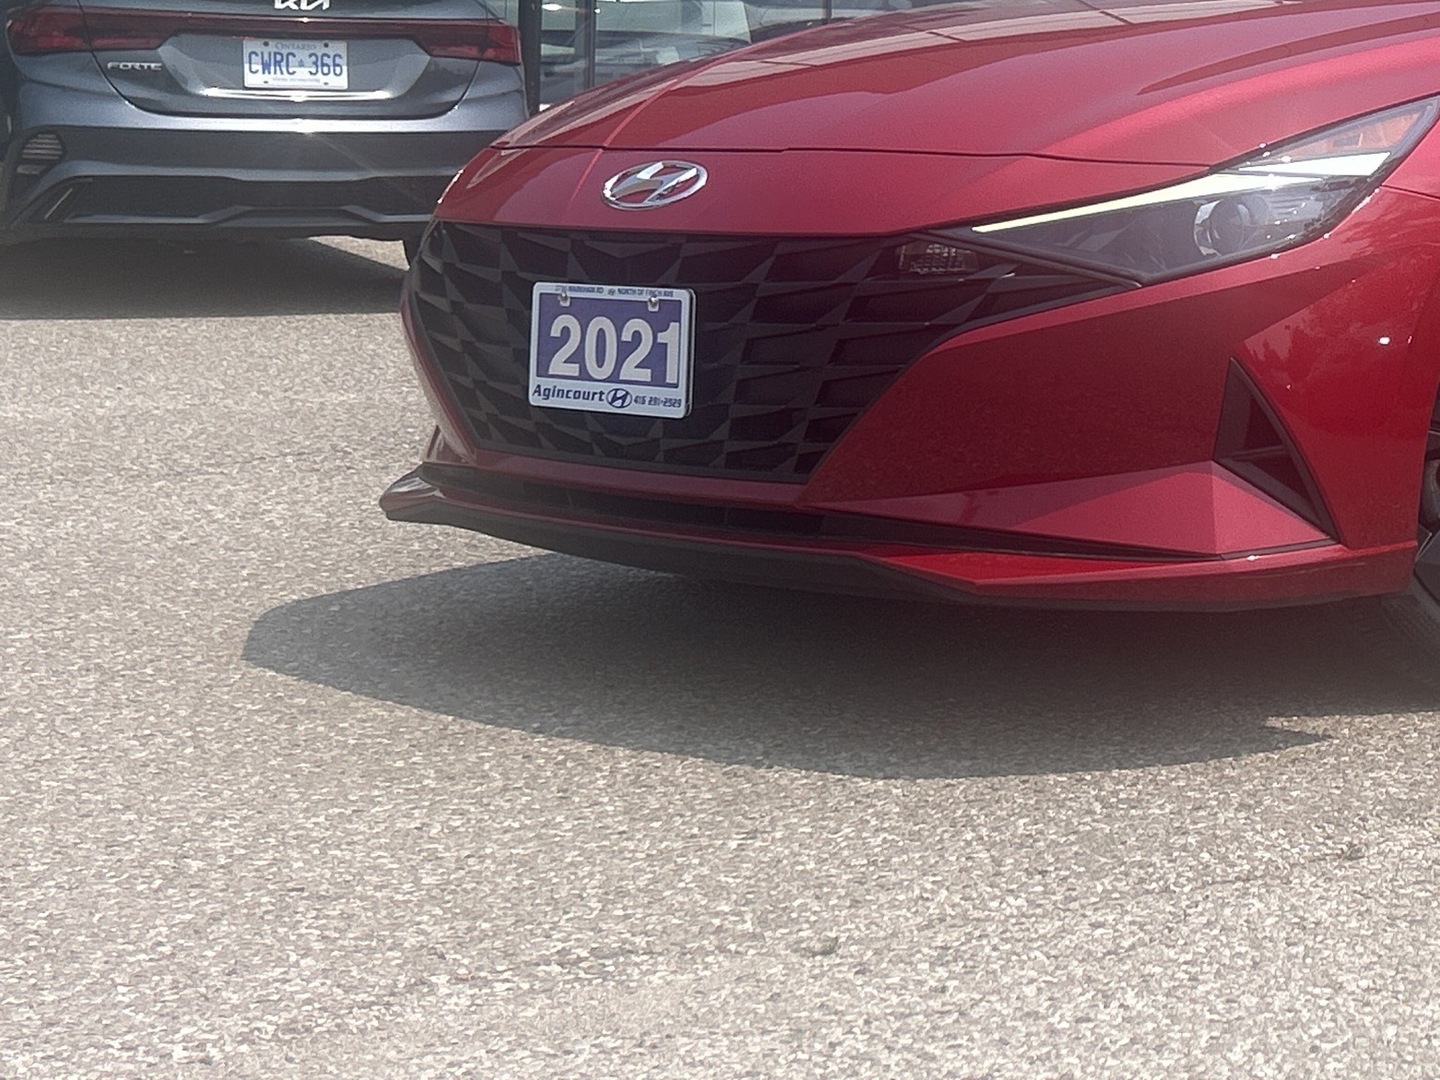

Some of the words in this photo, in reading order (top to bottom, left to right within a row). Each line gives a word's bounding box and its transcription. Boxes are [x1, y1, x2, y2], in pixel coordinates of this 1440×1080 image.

[107, 61, 162, 71] FORTE
[248, 51, 296, 76] CWRC
[308, 52, 343, 76] 366
[548, 314, 680, 384] 2021
[532, 384, 605, 402] Agincourt
